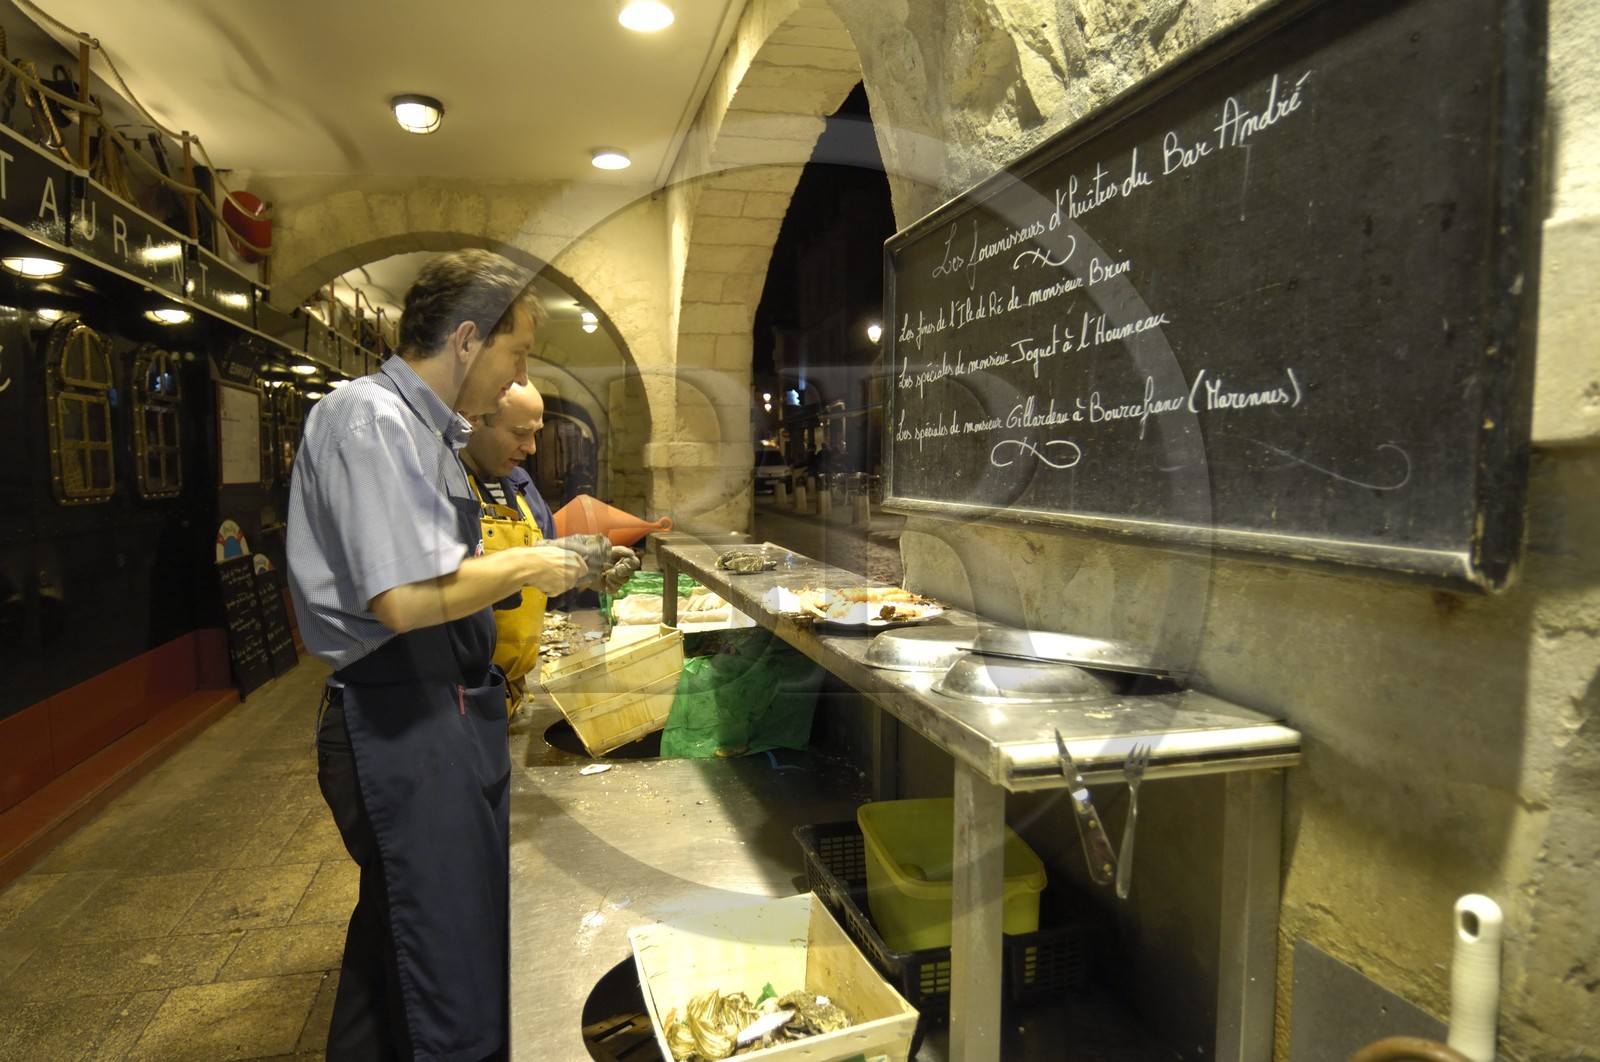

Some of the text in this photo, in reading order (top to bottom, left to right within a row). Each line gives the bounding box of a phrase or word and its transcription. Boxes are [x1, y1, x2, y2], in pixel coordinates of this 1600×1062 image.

[932, 222, 965, 279] Les
[966, 219, 1046, 291] fournisseurs
[1121, 146, 1153, 197] du
[1162, 131, 1214, 176] Bar
[1213, 71, 1311, 150] André
[898, 312, 915, 343] Les
[936, 306, 948, 333] de
[975, 294, 987, 320] de
[989, 290, 1004, 318] Ré
[1007, 285, 1023, 312] de
[1028, 277, 1084, 307] monsieur
[898, 356, 913, 389] Les
[954, 349, 966, 376] de
[967, 351, 1011, 375] monsieur
[1062, 327, 1075, 354] à
[896, 408, 913, 442] Les
[949, 409, 961, 435] de
[962, 415, 1004, 434] monsieur
[1072, 397, 1087, 422] à
[1187, 367, 1301, 414] (Marennes)
